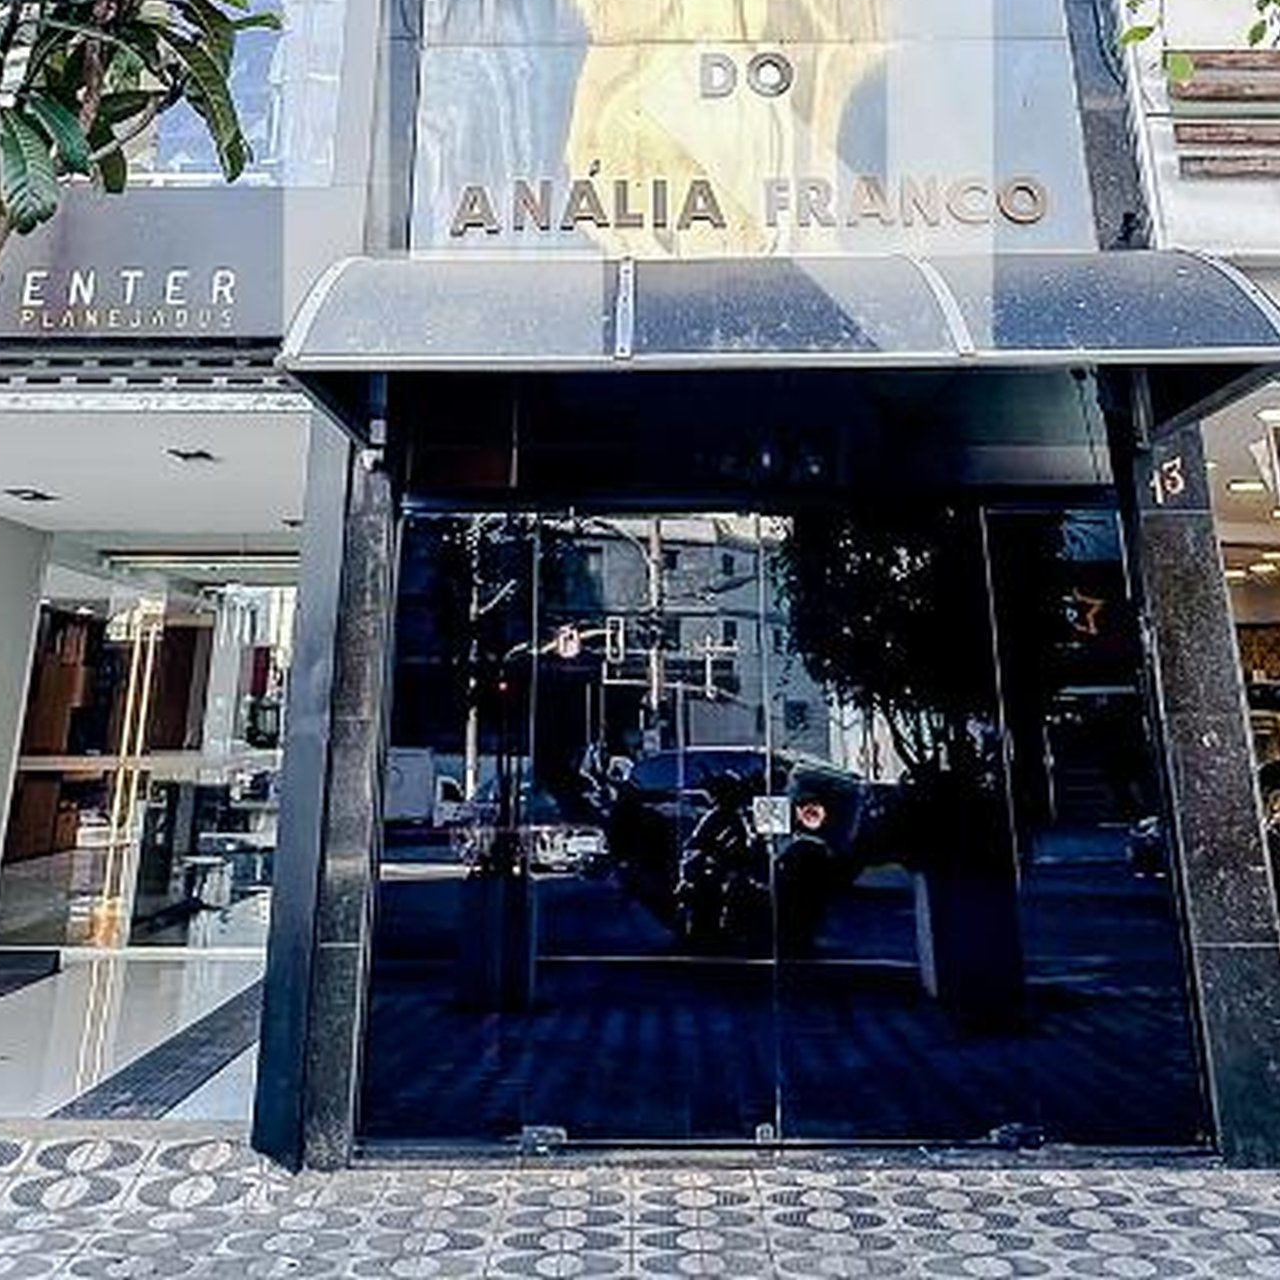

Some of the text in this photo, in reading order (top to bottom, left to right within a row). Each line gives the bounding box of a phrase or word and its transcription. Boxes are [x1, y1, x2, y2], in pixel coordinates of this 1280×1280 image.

[698, 51, 795, 99] DO
[450, 159, 1051, 237] ANÁLIA FRANCO
